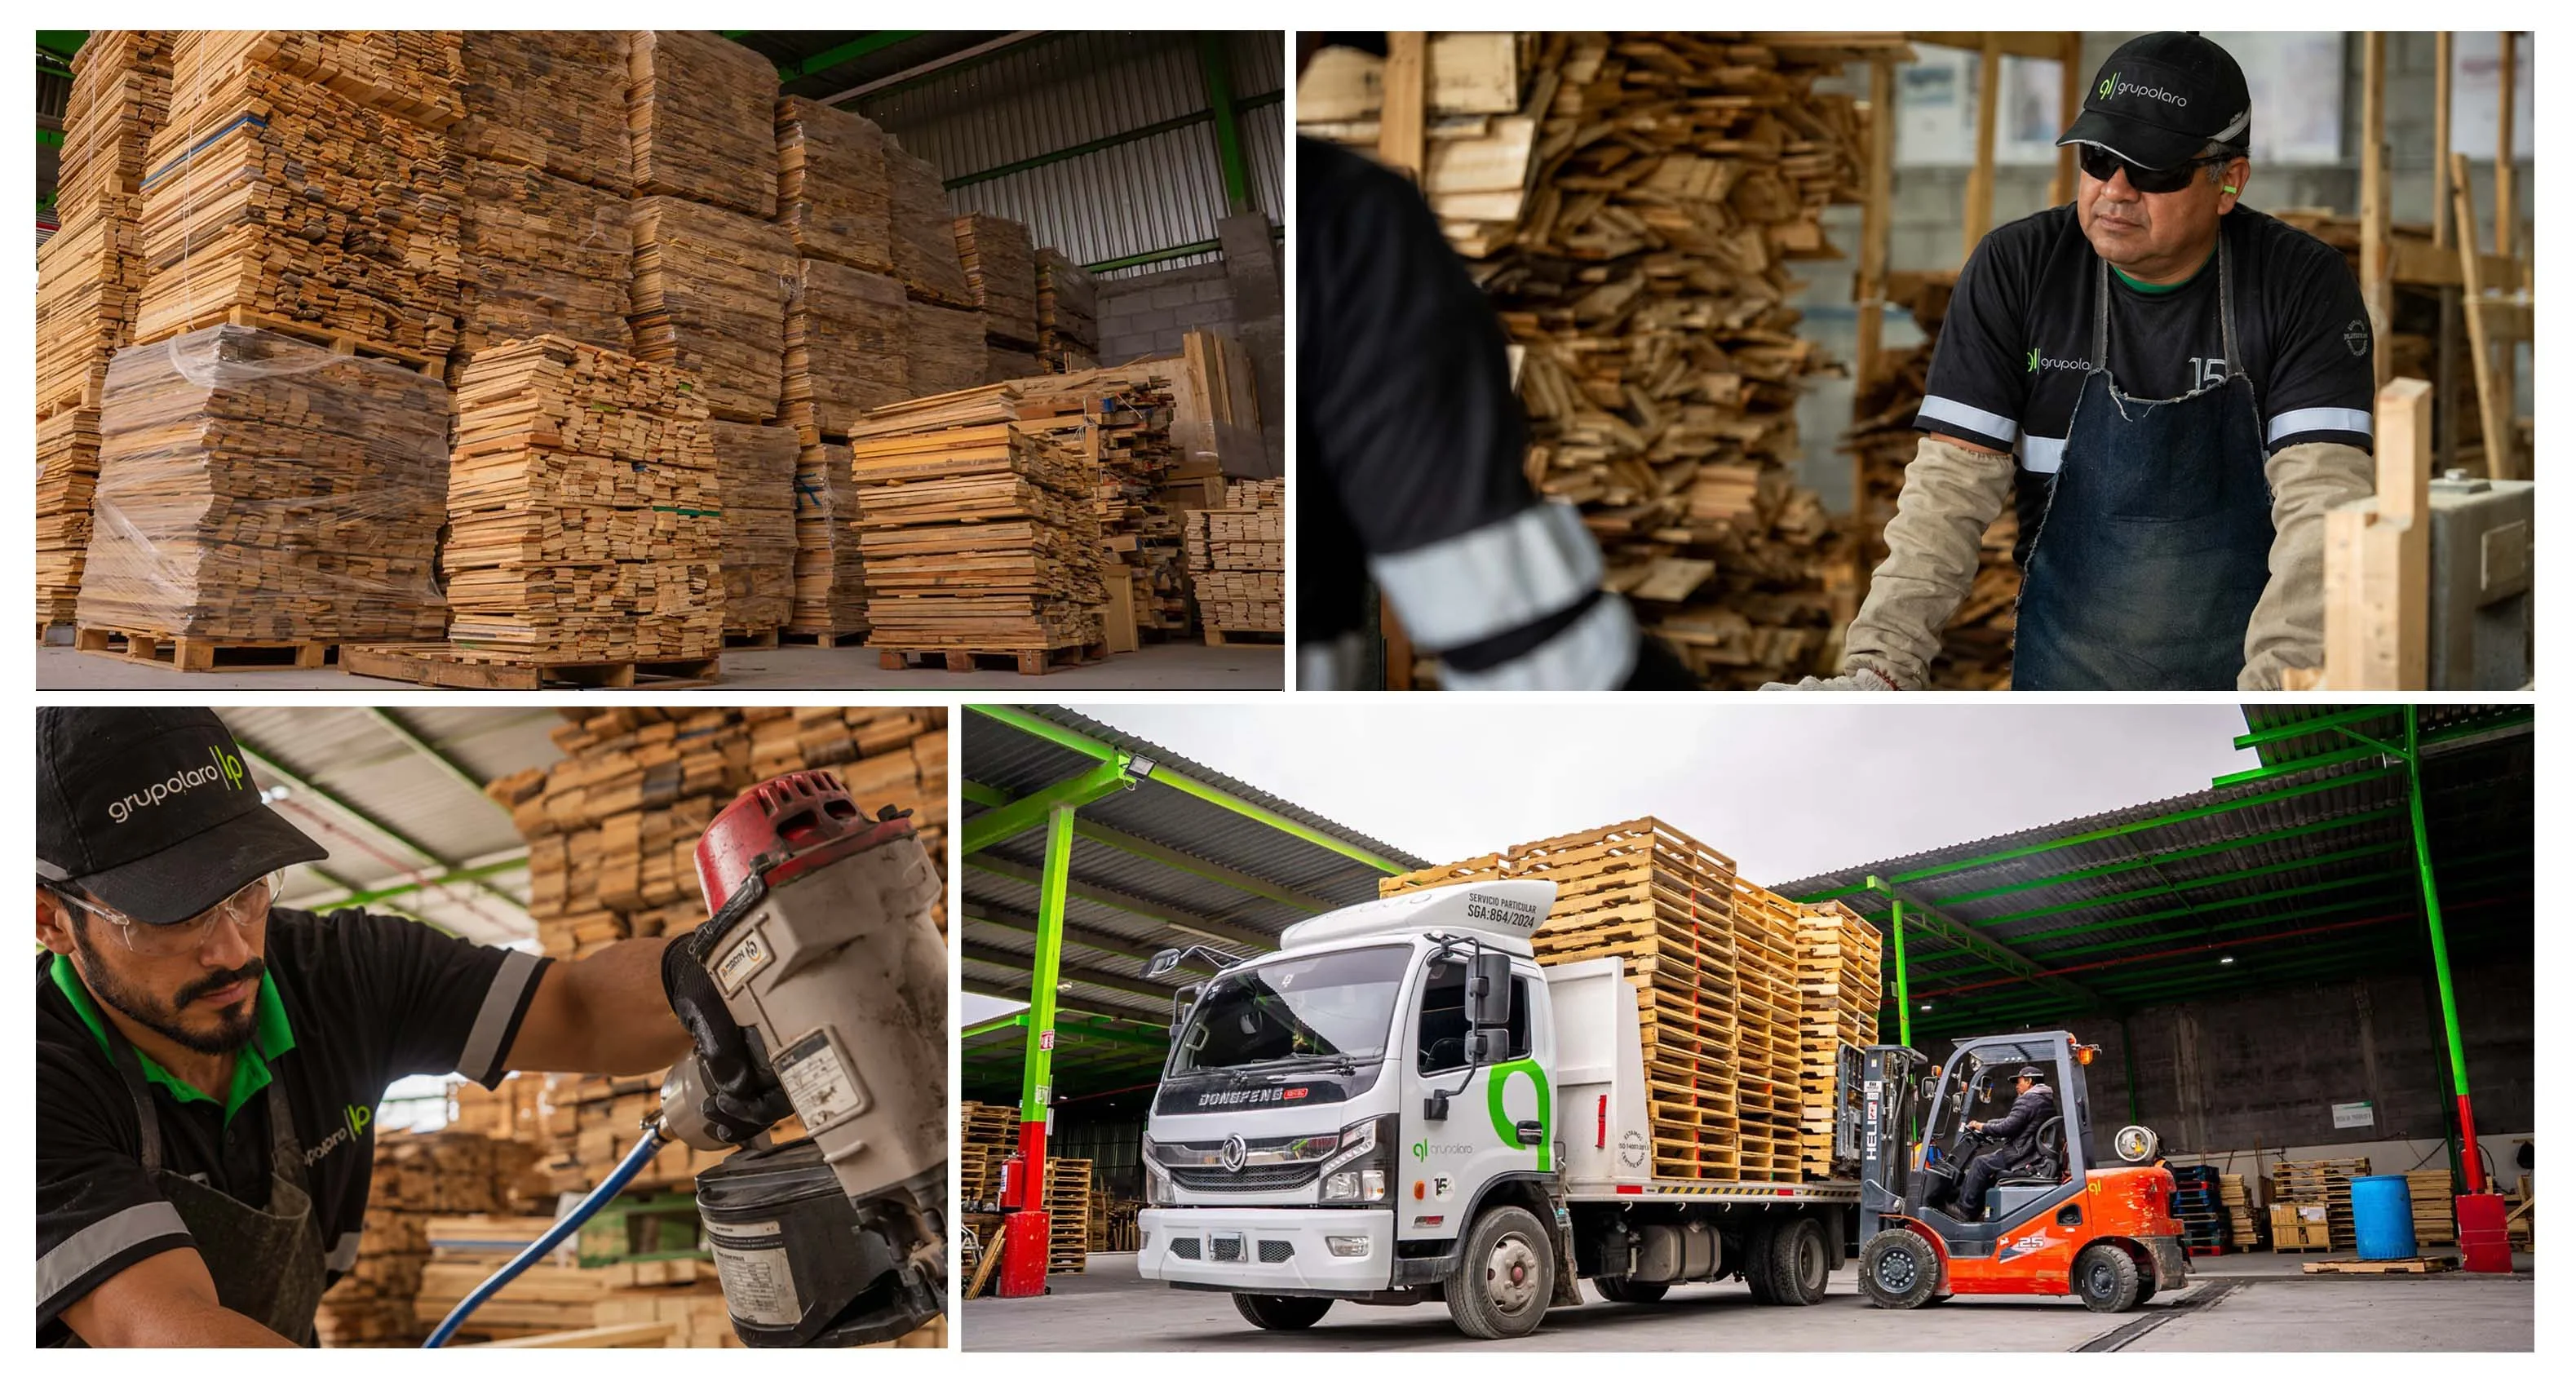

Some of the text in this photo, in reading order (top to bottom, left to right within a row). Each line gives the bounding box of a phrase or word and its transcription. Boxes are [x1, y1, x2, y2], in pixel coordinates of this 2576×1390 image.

[2118, 82, 2188, 108] grupolaro
[2040, 356, 2091, 371] grupola
[108, 764, 219, 824] grupolaro
[1468, 892, 1537, 914] SERVICIO PARTICULAR
[1467, 904, 1535, 928] SGA:864/2024
[1198, 1087, 1284, 1106] DONGFENG
[306, 1127, 347, 1167] polaro
[1866, 1120, 1878, 1161] HELI
[2018, 1236, 2044, 1247] 25
